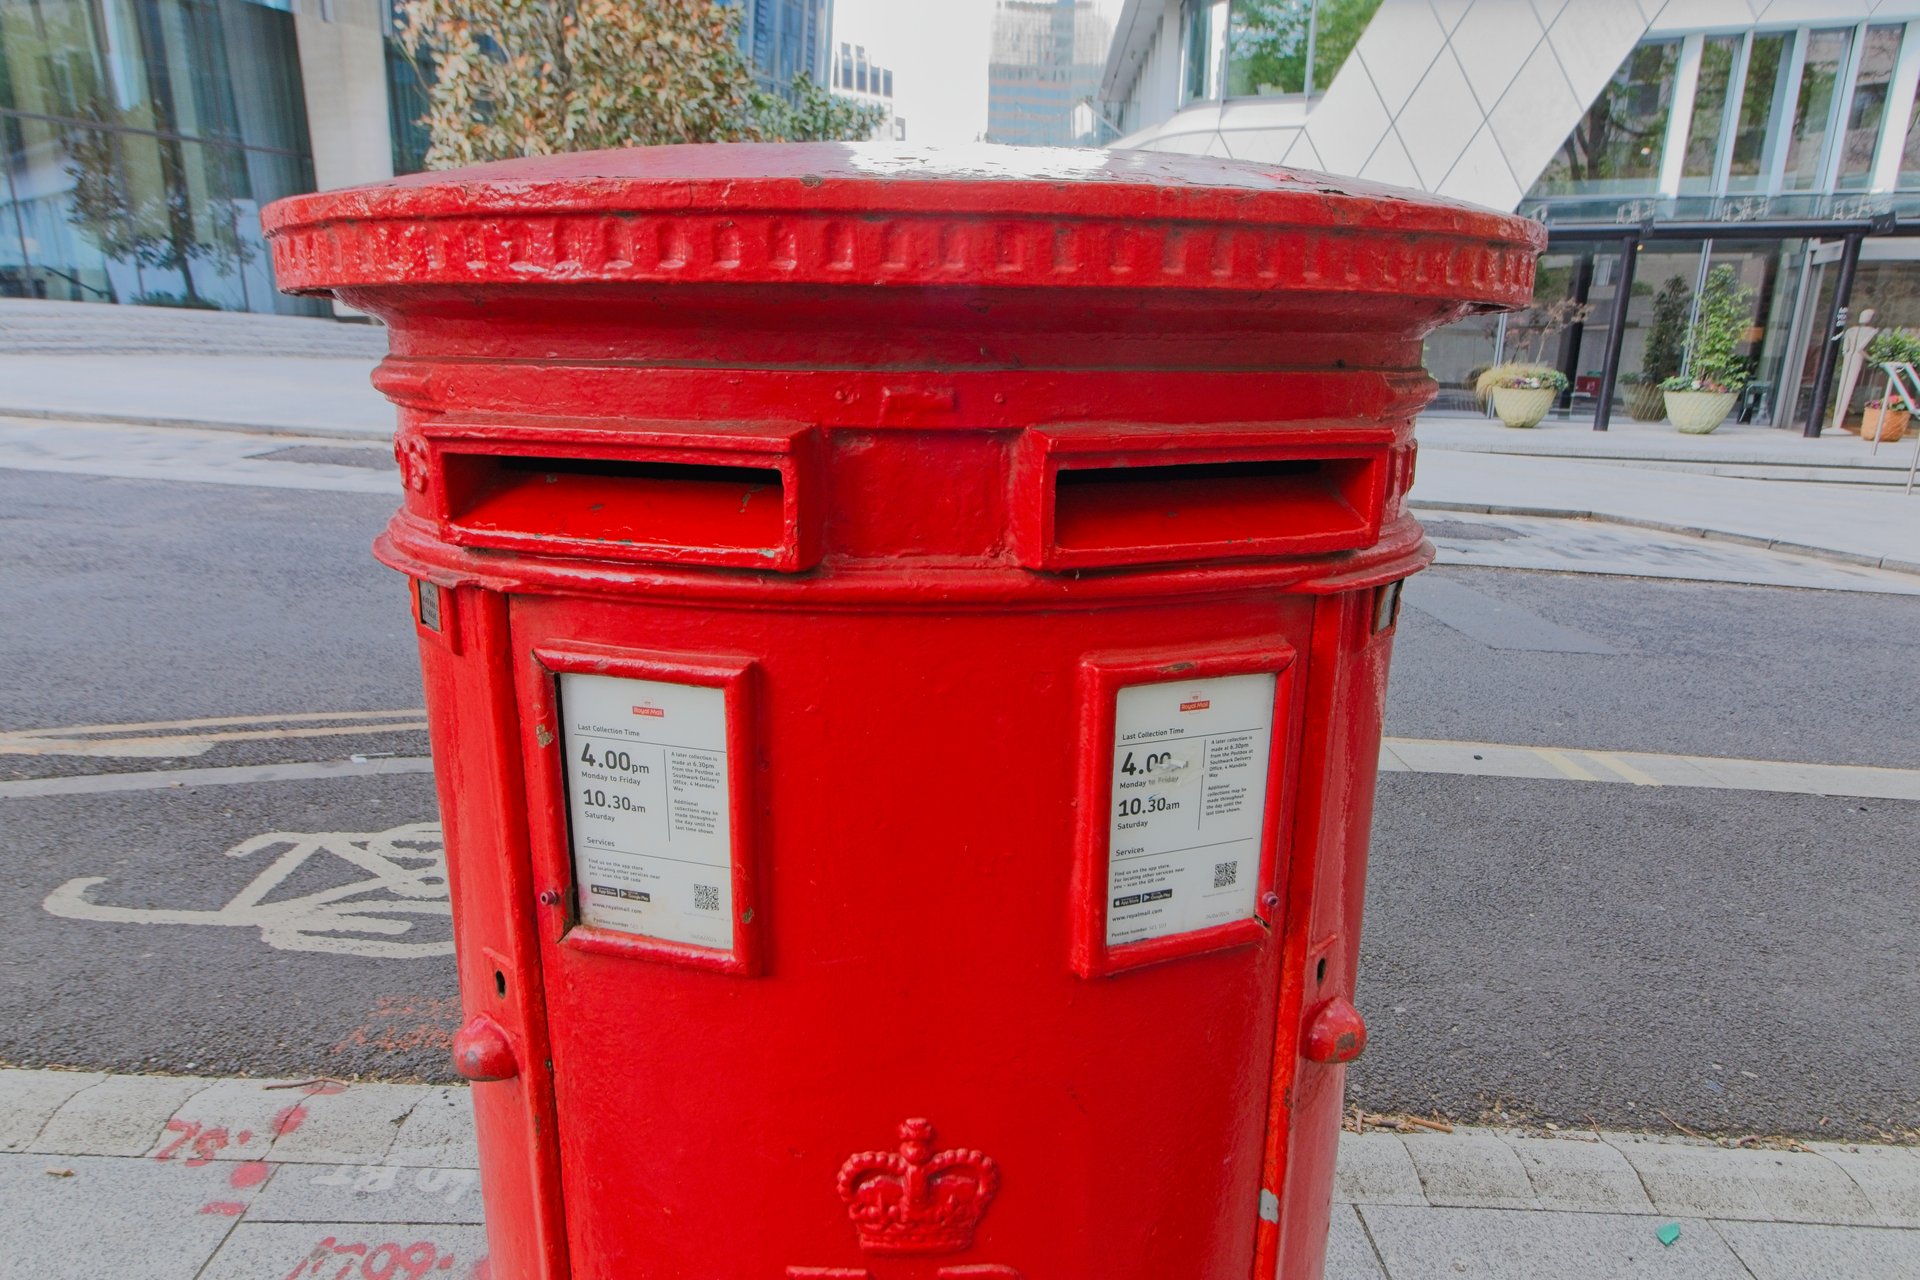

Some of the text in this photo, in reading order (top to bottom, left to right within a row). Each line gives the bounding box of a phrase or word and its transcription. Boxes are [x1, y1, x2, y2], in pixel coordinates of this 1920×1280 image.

[1181, 702, 1197, 710] Royal
[650, 708, 663, 716] Mail
[592, 725, 623, 735] Collection
[624, 729, 640, 737] Time
[1137, 730, 1168, 739] Collection
[581, 742, 650, 774] 4.00pm
[692, 761, 715, 769] 6.30pm
[581, 771, 608, 782] Monday
[619, 776, 641, 786] Friday
[672, 772, 698, 780] Southwark
[1119, 780, 1147, 789] Monday
[1157, 776, 1179, 784] Friday
[583, 789, 646, 813] 10.30am
[1118, 797, 1180, 817] 10.30am
[584, 810, 615, 822] Saturday
[689, 814, 717, 822] throughout
[1117, 820, 1148, 831] Saturday
[586, 836, 615, 847] Services
[1115, 847, 1145, 857] Services
[597, 865, 616, 874] locating
[1122, 874, 1141, 882] locating
[592, 902, 643, 914] www.royalmail.com
[1112, 908, 1163, 922] www.royalmail.com
